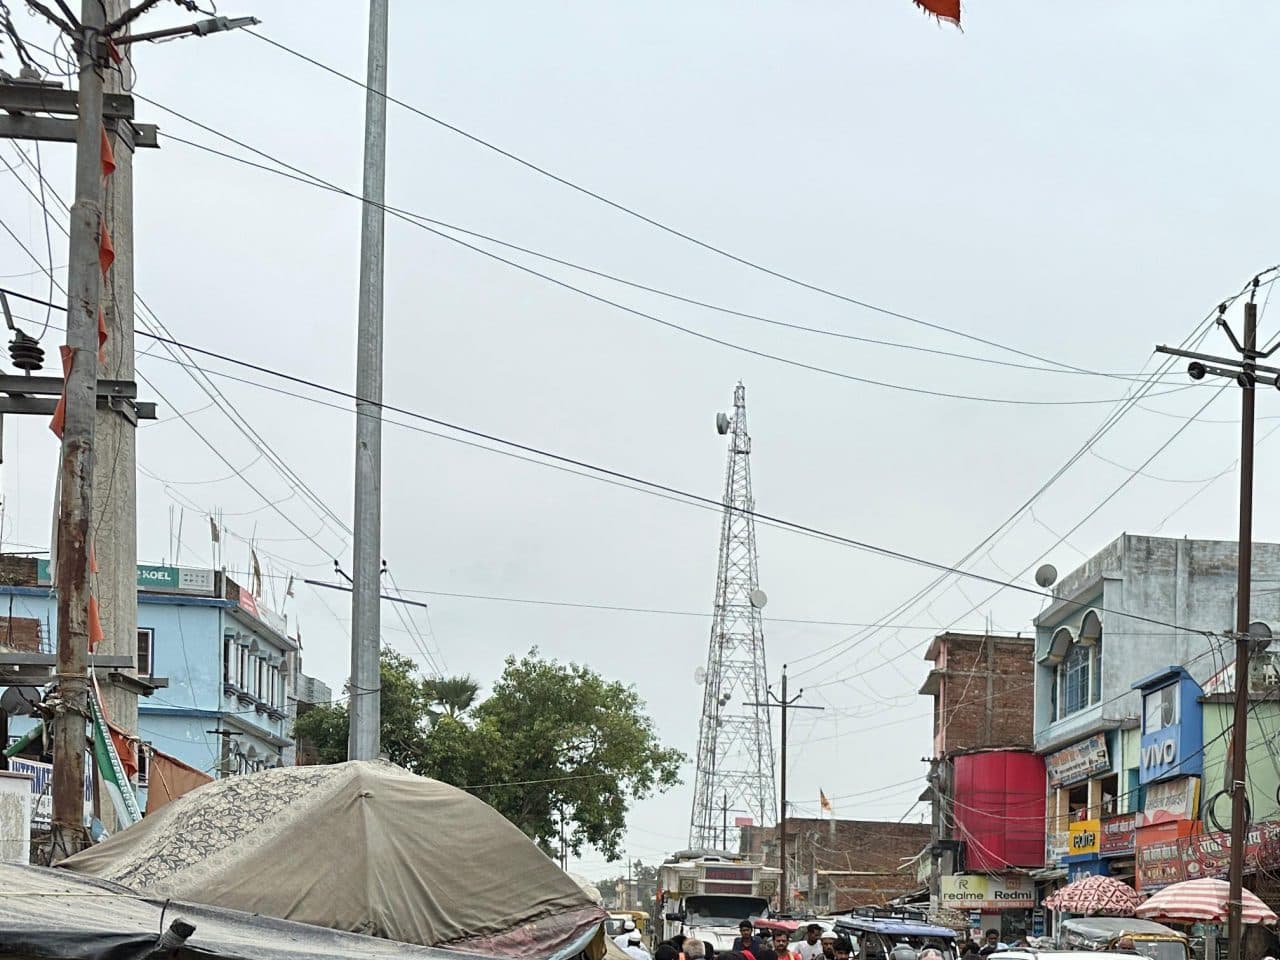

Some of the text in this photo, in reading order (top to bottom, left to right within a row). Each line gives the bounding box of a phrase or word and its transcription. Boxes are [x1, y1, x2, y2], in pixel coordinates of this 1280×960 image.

[142, 571, 171, 581] KOEL
[943, 890, 984, 900] realme
[994, 890, 1032, 900] Redmi
